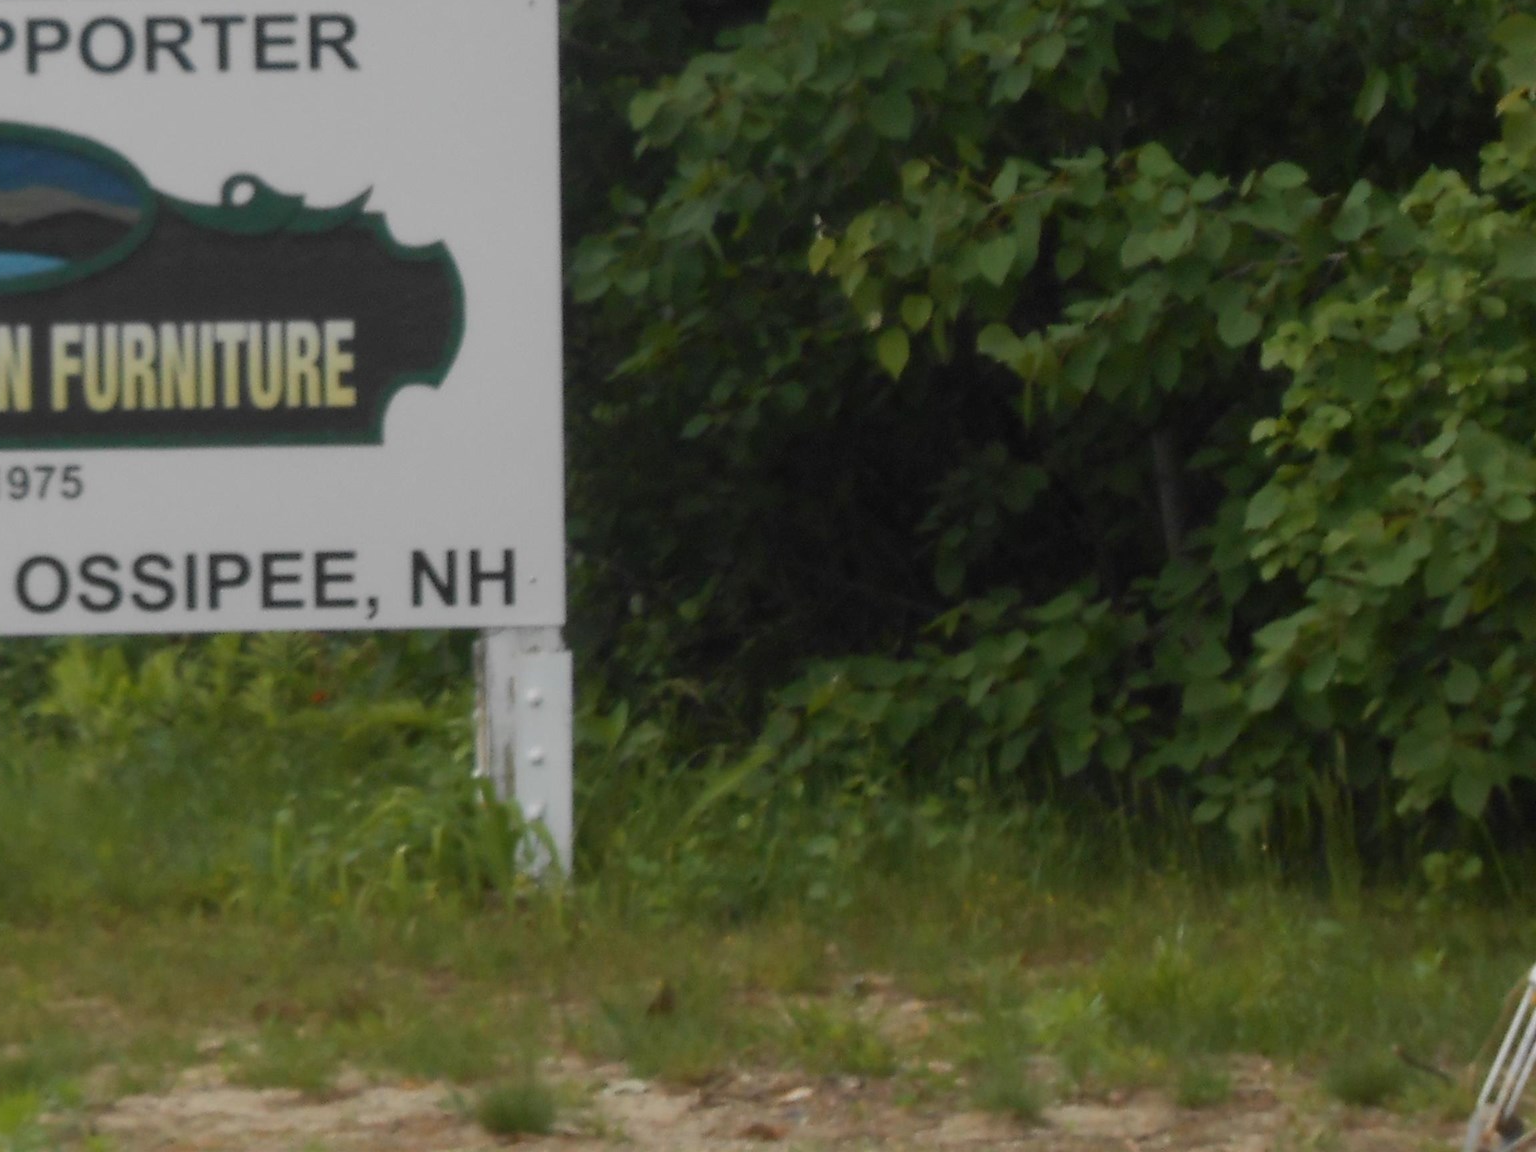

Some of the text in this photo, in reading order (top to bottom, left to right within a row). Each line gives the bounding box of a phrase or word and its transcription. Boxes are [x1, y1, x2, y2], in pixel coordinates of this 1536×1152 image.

[49, 319, 357, 412] FURNITURE
[13, 549, 382, 628] OSSIPEE,
[408, 546, 518, 610] NH
